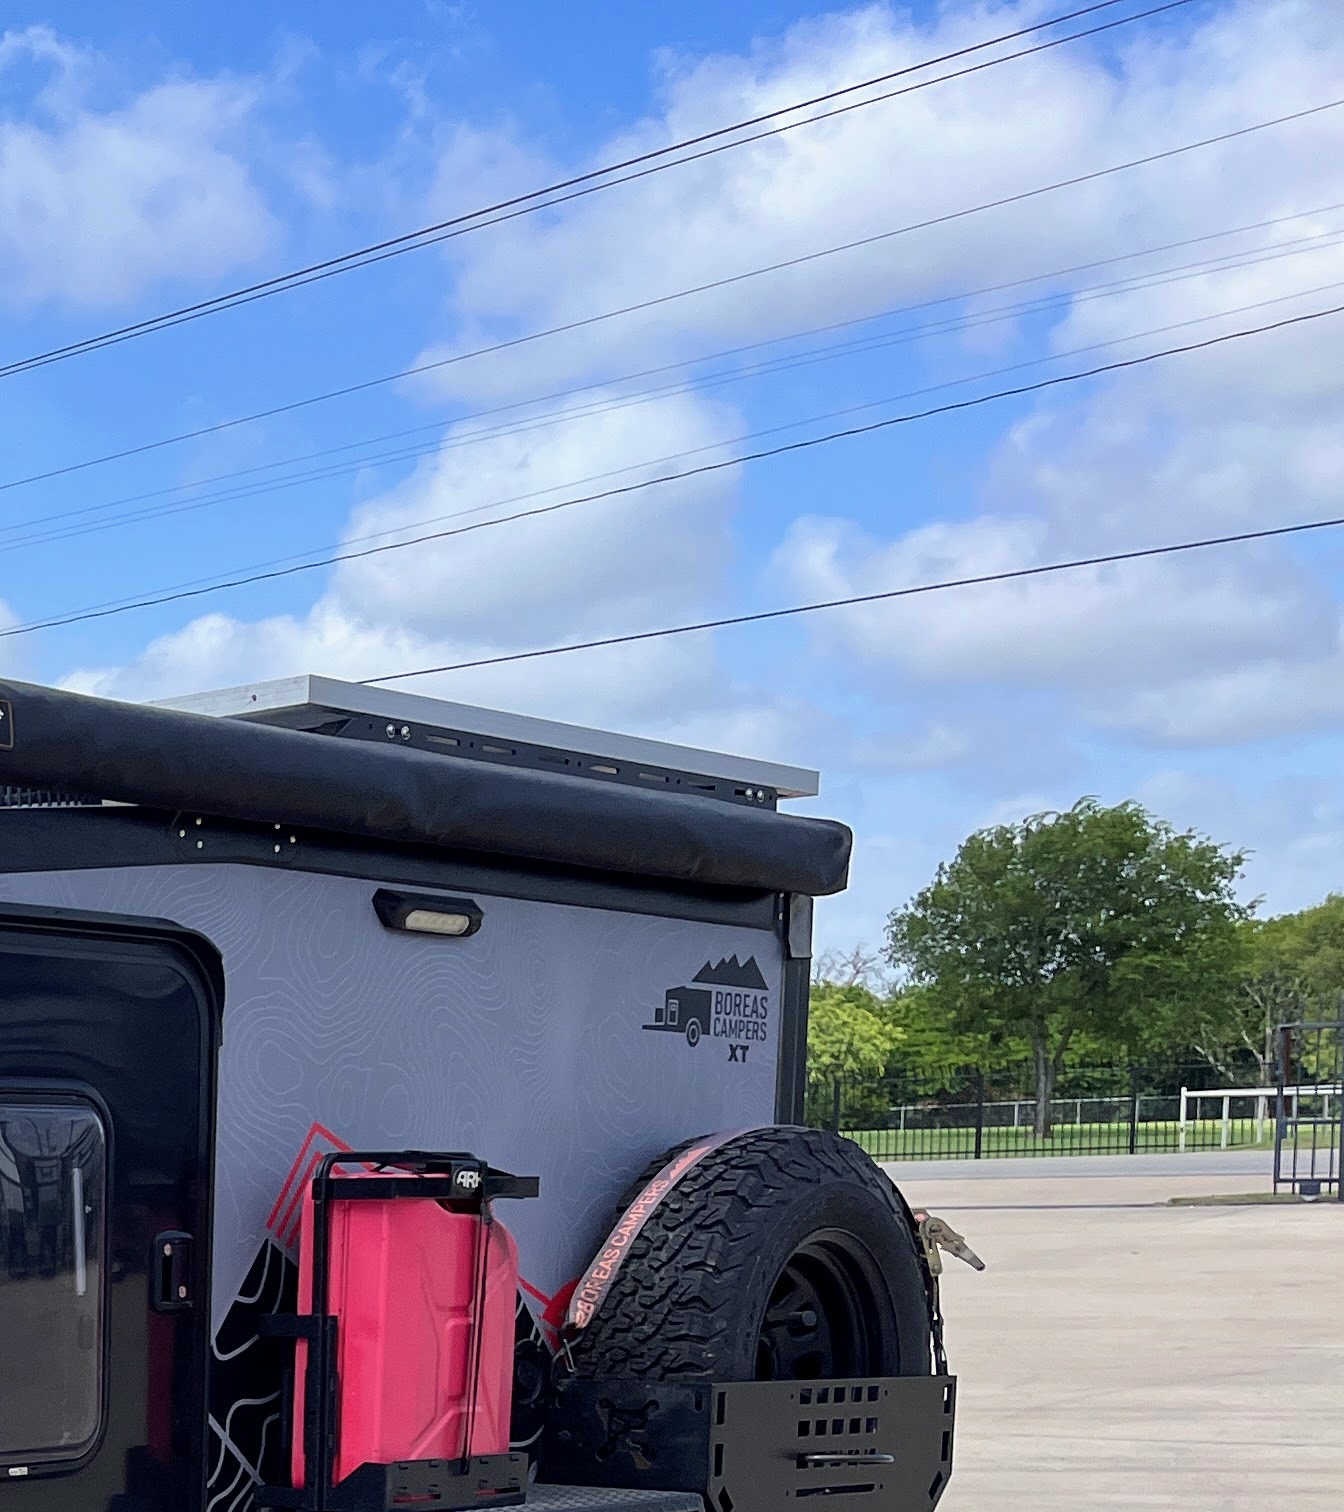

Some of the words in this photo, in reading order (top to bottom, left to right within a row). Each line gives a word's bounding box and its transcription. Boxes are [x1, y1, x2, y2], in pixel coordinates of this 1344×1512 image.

[714, 991, 769, 1019] BOREAS
[713, 1017, 768, 1042] CAMPERS
[727, 1043, 750, 1063] XT
[576, 1247, 621, 1313] BOREAS
[612, 1178, 670, 1247] CAMPERS
